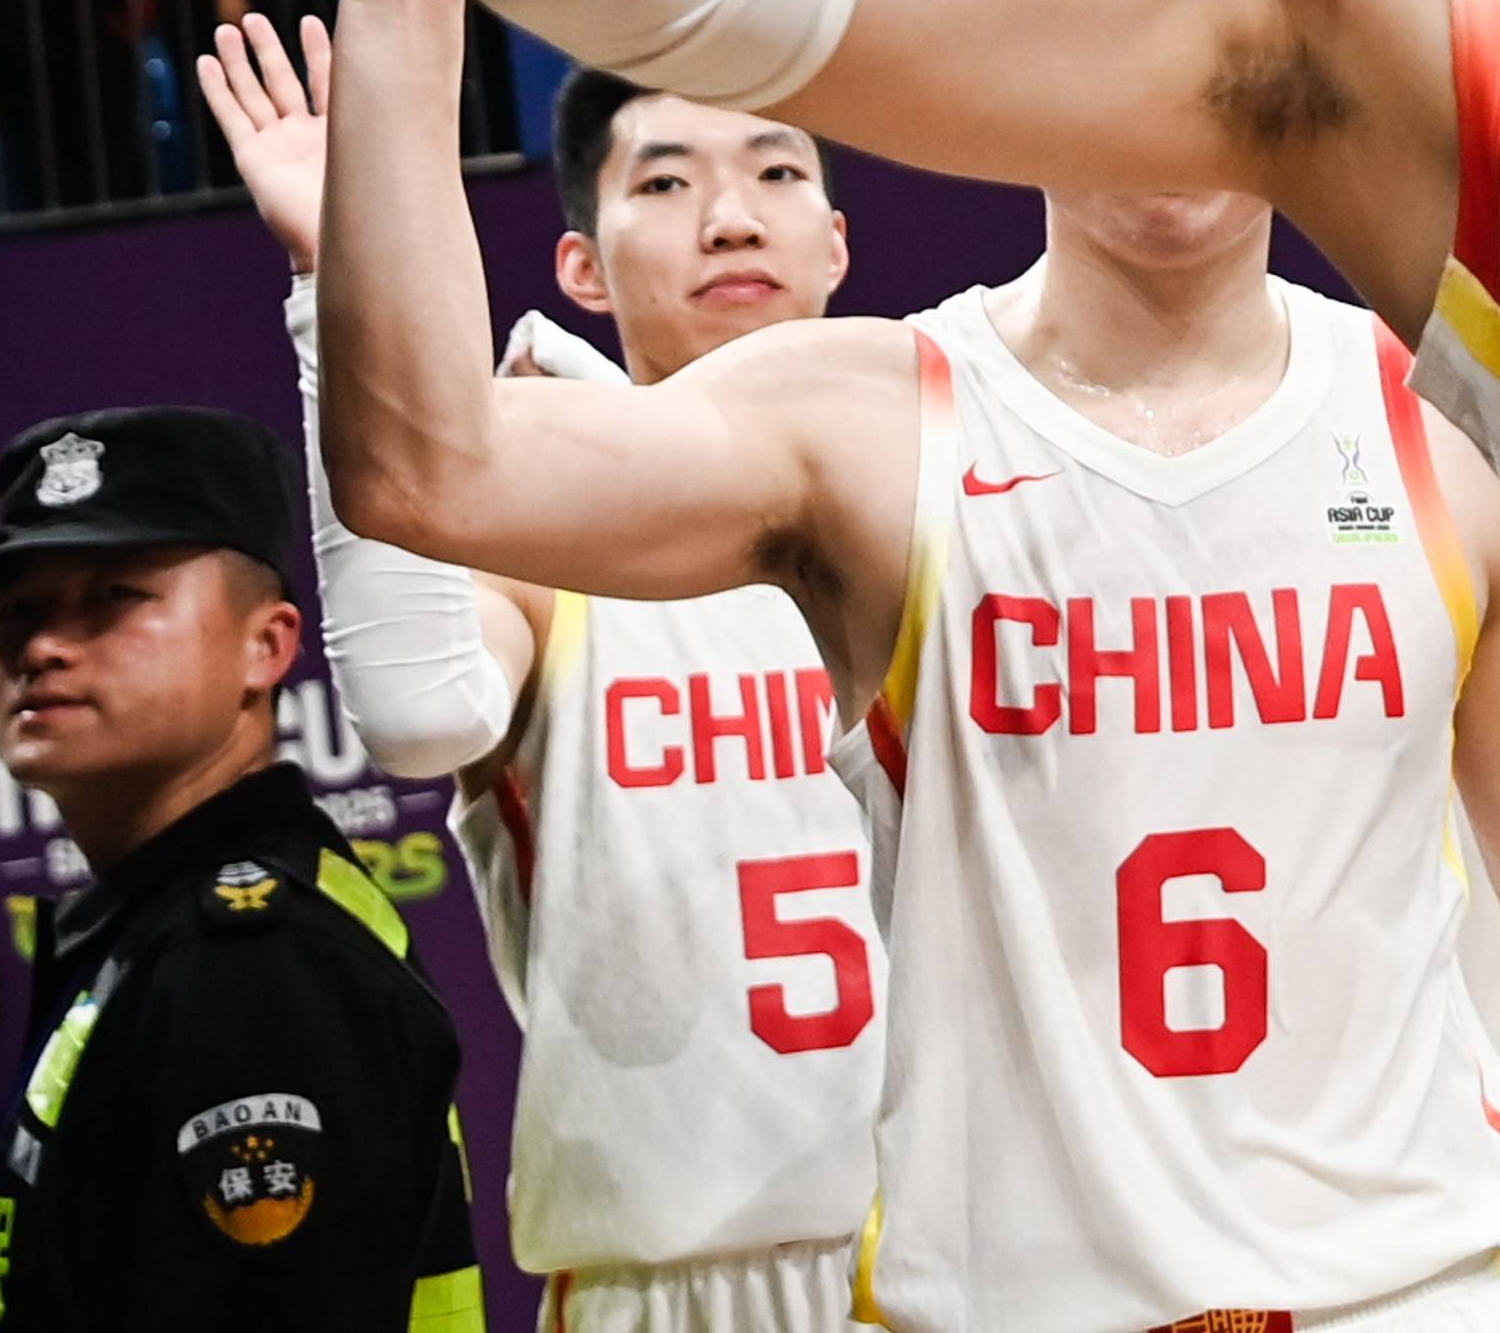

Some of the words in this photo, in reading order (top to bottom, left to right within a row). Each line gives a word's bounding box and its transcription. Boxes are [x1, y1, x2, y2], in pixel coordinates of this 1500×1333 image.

[1327, 506, 1363, 523] ASIA
[1365, 506, 1395, 522] CUP
[968, 583, 1405, 737] CHINA
[737, 850, 875, 1055] 5
[1115, 826, 1268, 1079] 6
[218, 1159, 298, 1205] 保安
